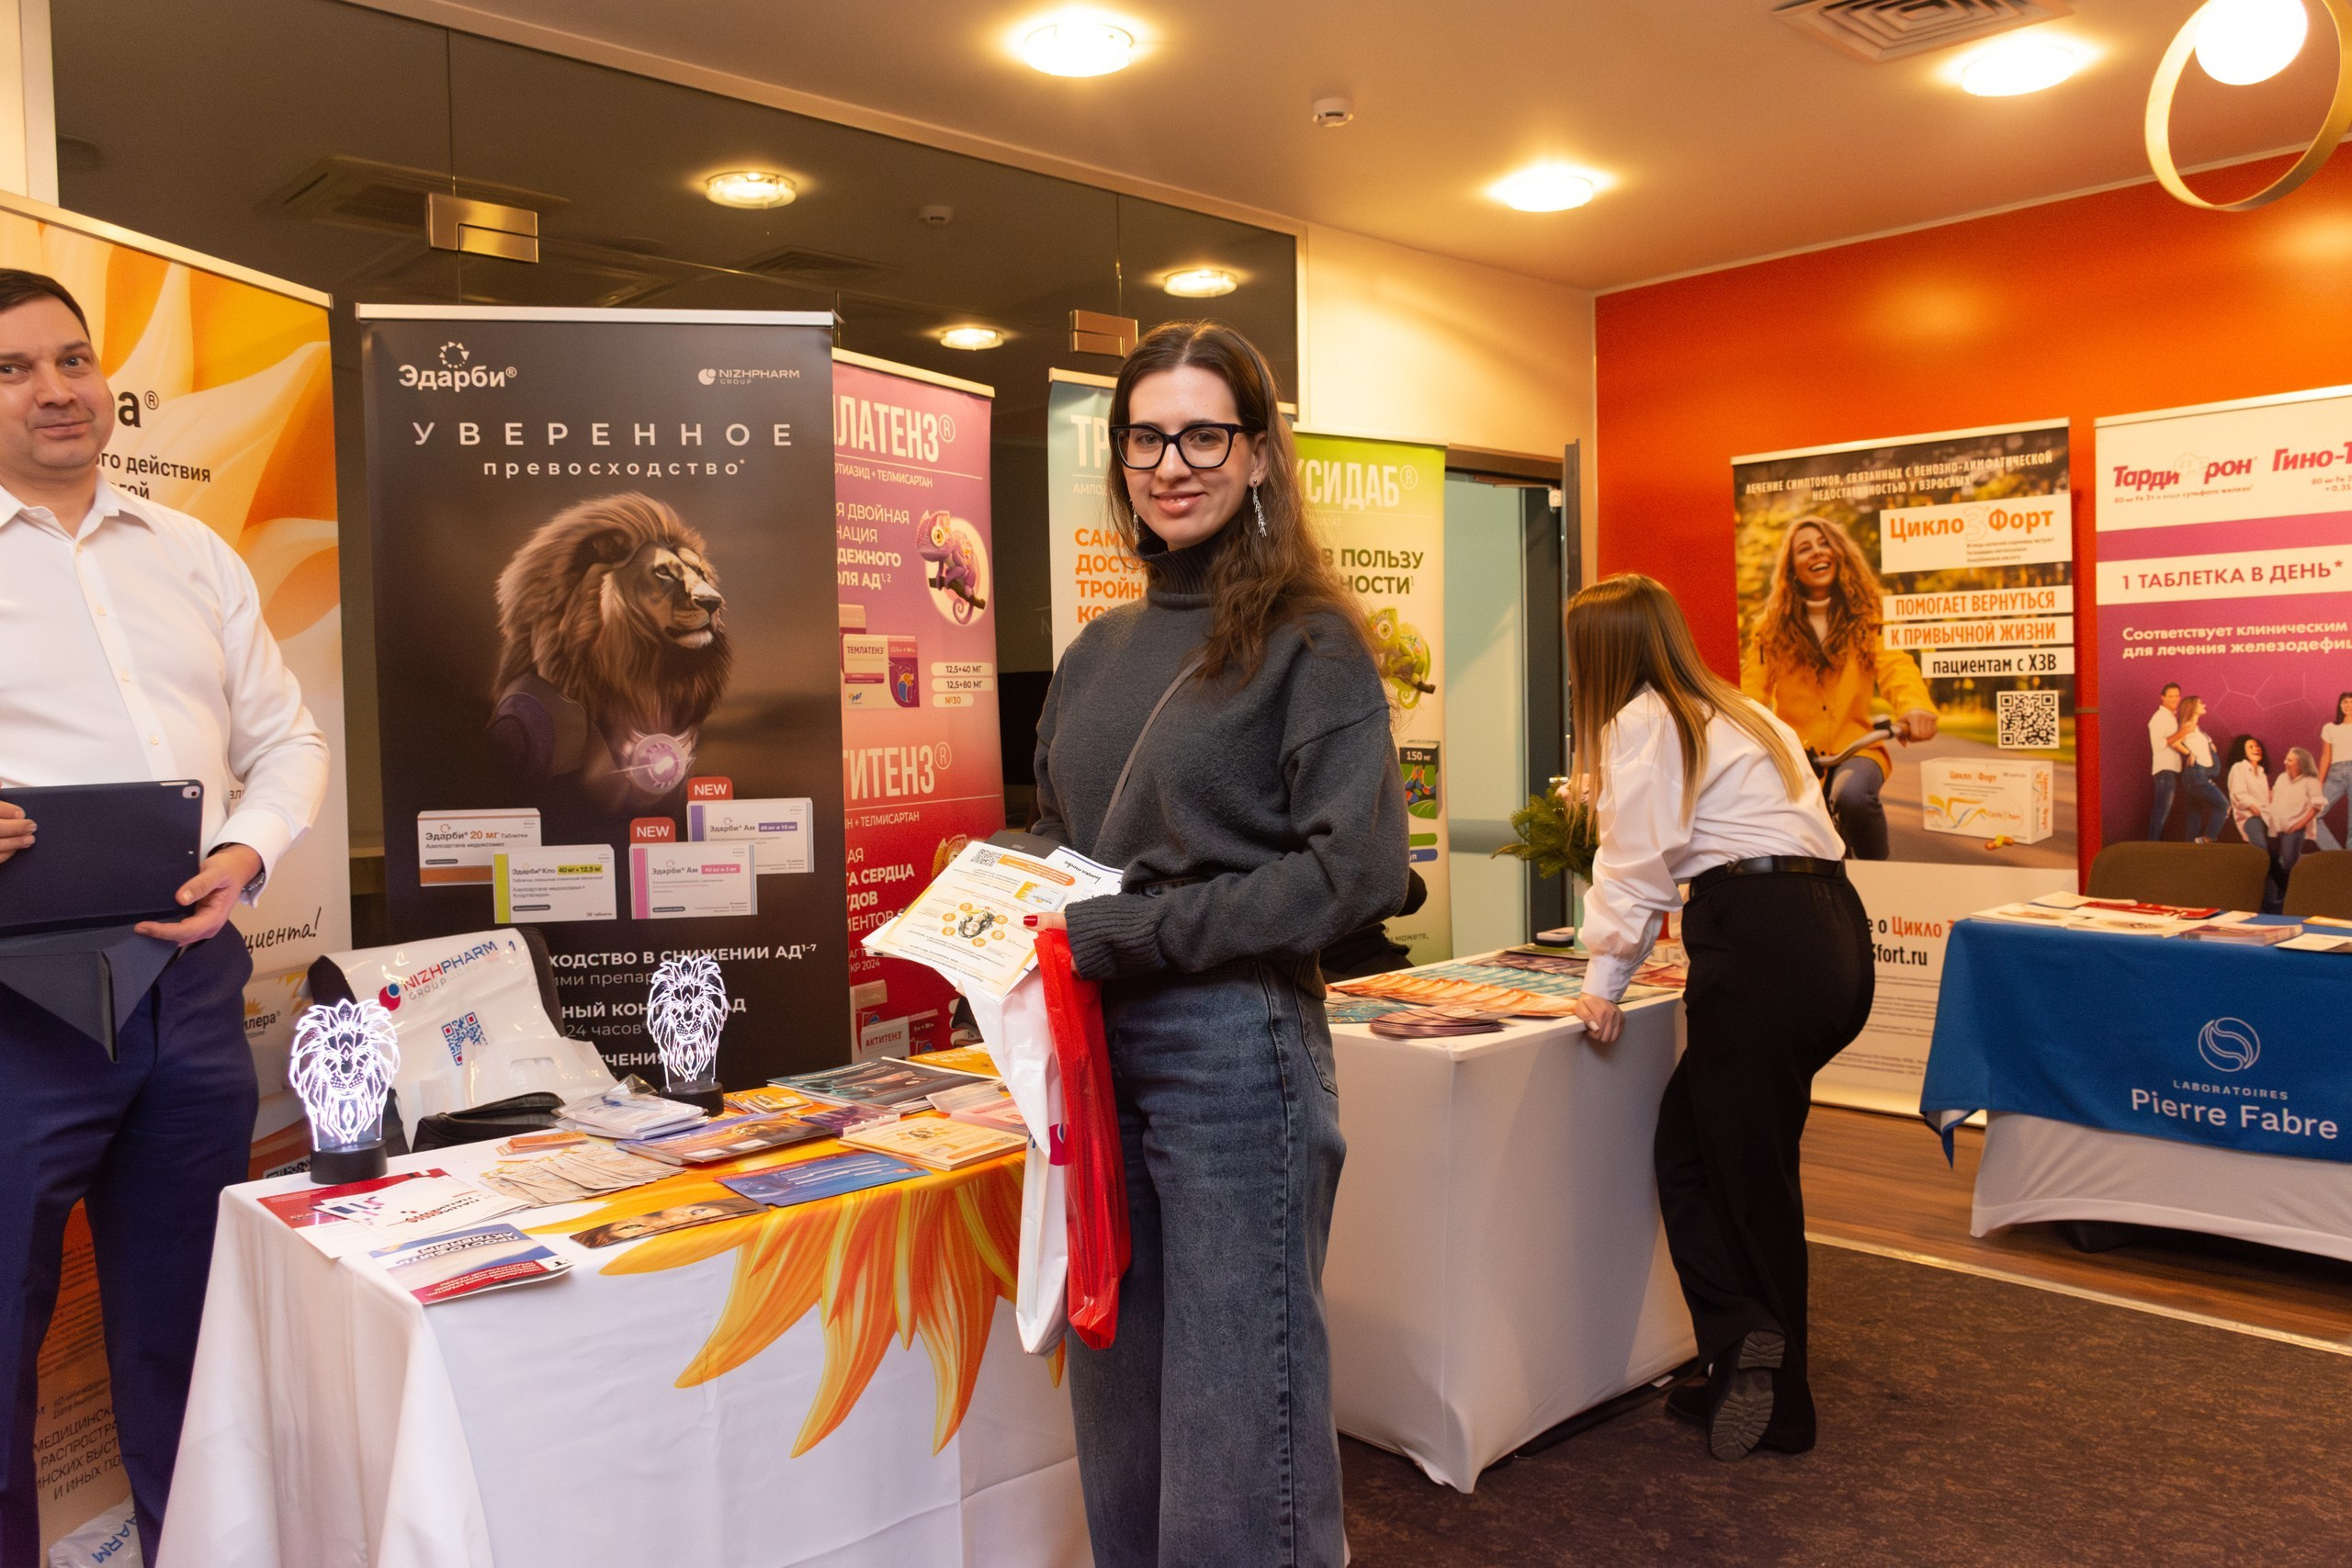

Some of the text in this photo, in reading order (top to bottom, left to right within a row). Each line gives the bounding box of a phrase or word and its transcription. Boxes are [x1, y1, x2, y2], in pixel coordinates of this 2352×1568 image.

[718, 368, 800, 379] NIZHPHARM
[413, 422, 792, 446] УВЕРЕННОЕ
[832, 394, 956, 463] ЛАТЕНЗ®
[126, 455, 212, 483] действия
[877, 468, 933, 488] ТЕЛМИСАРТАН
[1746, 479, 1784, 495] ЛЕЧЕНИЕ
[1846, 468, 1903, 485] СВЯЗАННЫХ
[848, 502, 910, 525] ДВОЙНАЯ
[836, 525, 878, 545] НАЦИЯ
[1889, 516, 1964, 543] Цикло
[1988, 507, 2054, 535] Форт
[837, 547, 902, 567] ДЕЖНОГО
[1340, 548, 1424, 570] ПОЛЬЗУ
[1076, 578, 1144, 599] ТРОЙН
[2122, 575, 2130, 590] 1
[2138, 567, 2245, 589] ТАБЛЕТКА
[2251, 566, 2264, 581] В
[1895, 591, 2055, 616] ПОМОГАЕТ ВЕРНУТЬСЯ
[1891, 621, 2056, 647] К ПРИВЫЧНОЙ ЖИЗНИ
[2122, 620, 2348, 641] Соответствует клиническим
[846, 646, 884, 655] ТЕМЛАТЕНЗ
[2122, 647, 2153, 660] для
[2156, 642, 2226, 657] лечения
[972, 664, 982, 673] МГ
[1932, 653, 2058, 676] пациентам с ХЗВ
[973, 680, 983, 689] МГ
[1406, 750, 1422, 761] 150
[694, 784, 727, 795] NEW
[860, 811, 920, 828] ТЕЛМИСАРТАН
[469, 830, 483, 840] 20
[637, 825, 670, 838] NEW
[860, 863, 915, 885] СЕРДЦА
[244, 906, 322, 955] циента!
[1878, 919, 1887, 934] о
[1892, 916, 1942, 938] Цикло
[401, 940, 498, 992] NIZHPHARM
[549, 951, 639, 969] ХОДСТВО
[642, 950, 655, 964] В
[566, 1023, 587, 1038] 24
[865, 1031, 902, 1048] АКТИТЕНЗ
[2173, 1079, 2289, 1100] LABORATOIRES
[2131, 1089, 2339, 1140] Pierre Fabre
[34, 1405, 113, 1453] МЕДИЦИНСК
[40, 1420, 118, 1470] РАСПРОСТР
